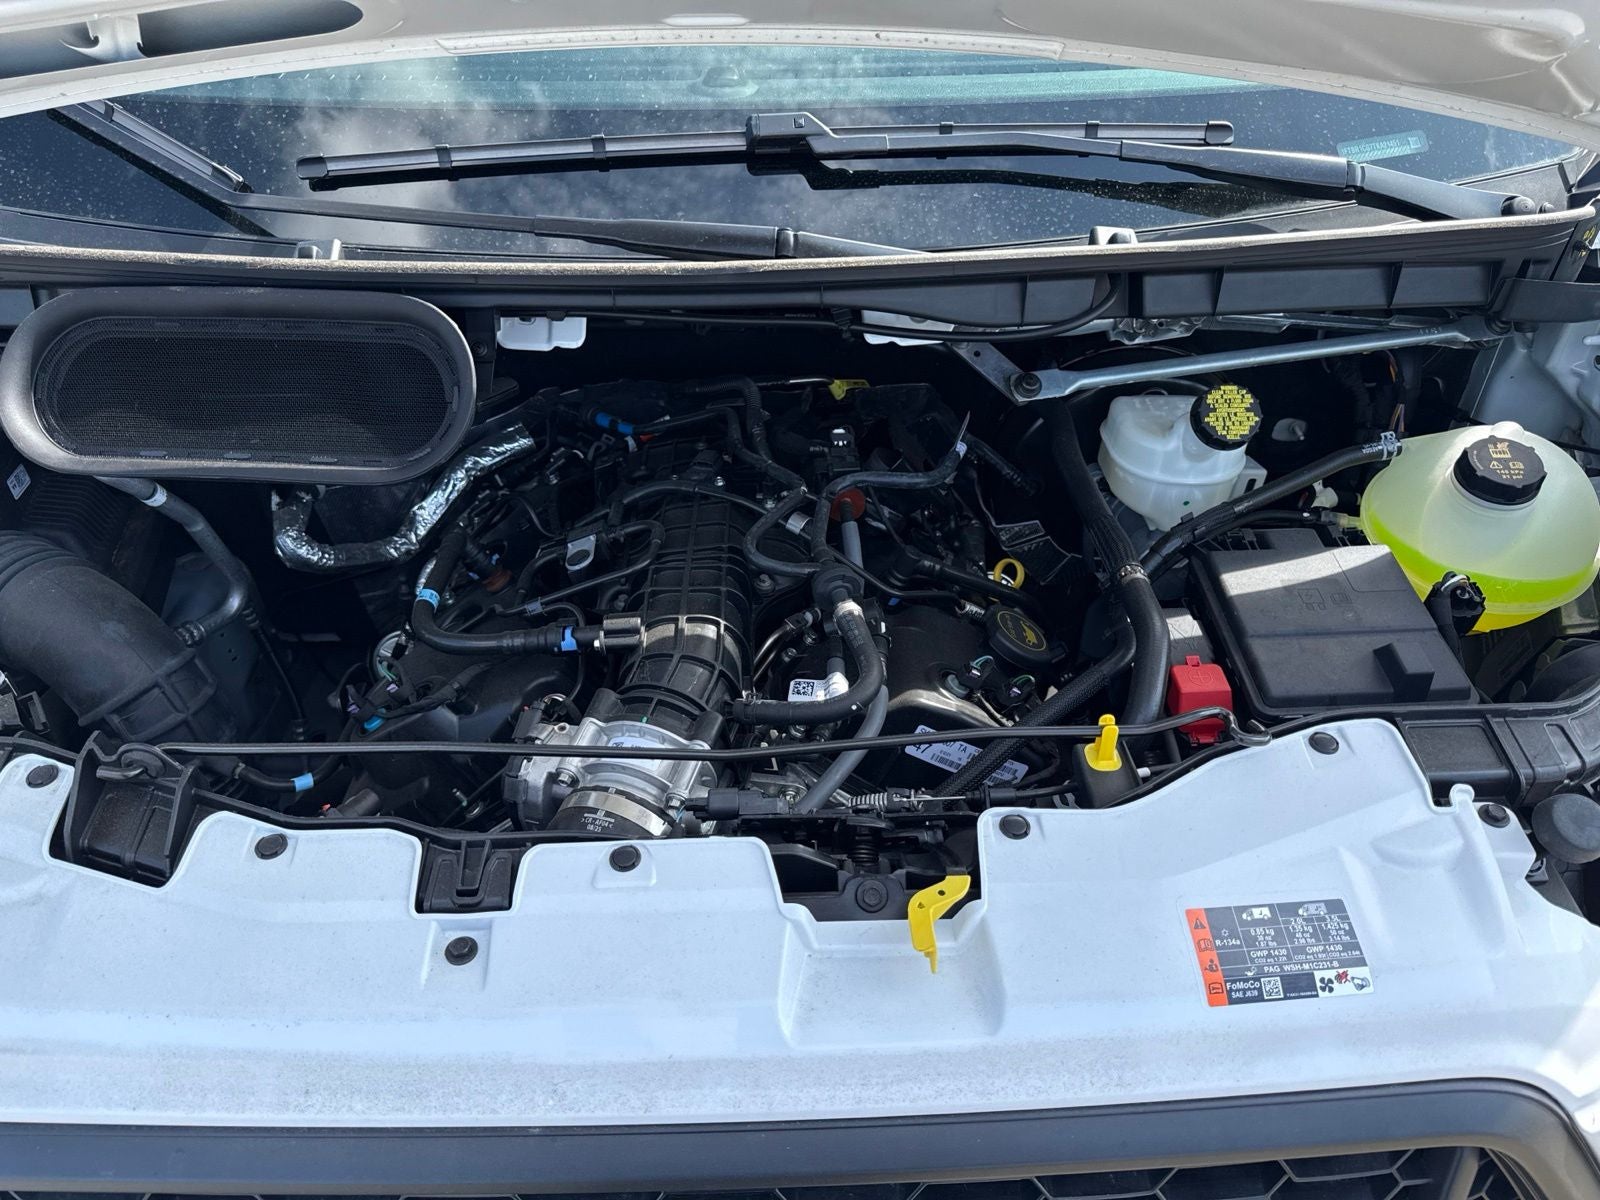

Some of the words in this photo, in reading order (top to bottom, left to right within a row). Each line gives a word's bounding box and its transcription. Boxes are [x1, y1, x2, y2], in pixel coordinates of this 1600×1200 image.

[1266, 928, 1274, 936] kg
[1303, 924, 1313, 933] kg
[1215, 938, 1240, 946] R-134a
[1270, 948, 1287, 956] 1430
[1263, 965, 1280, 973] PAG
[1282, 960, 1339, 972] WSH-M1C231-B
[1226, 980, 1260, 990] FoMoCo
